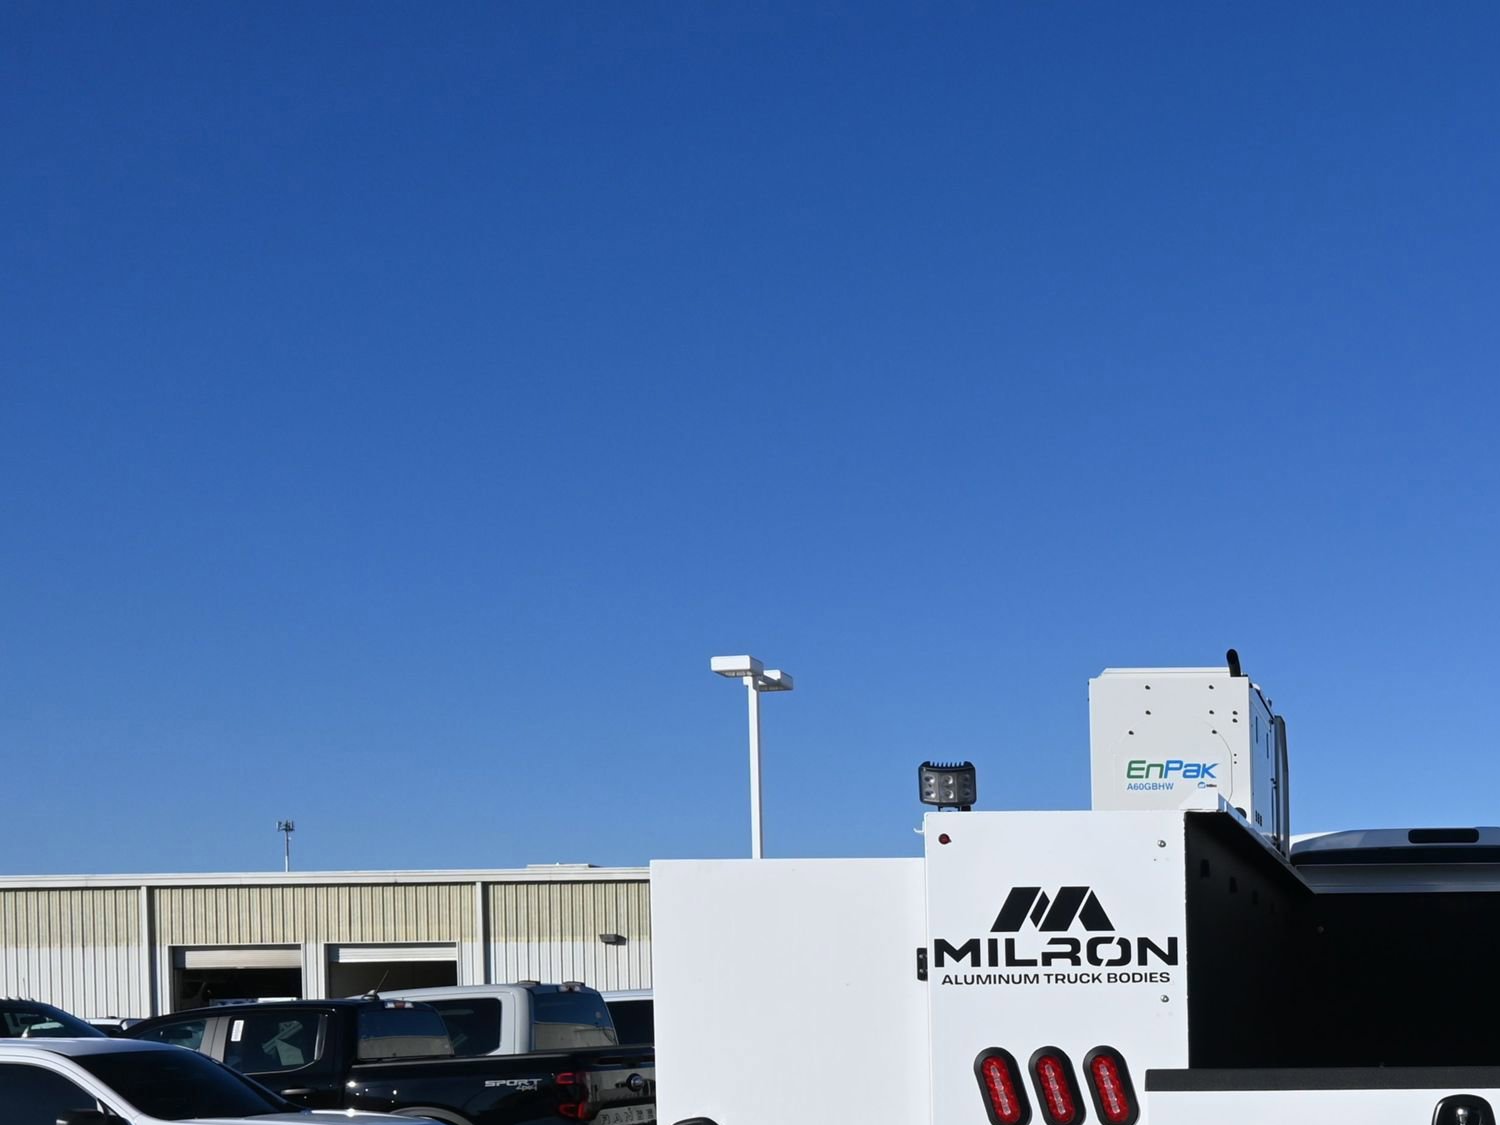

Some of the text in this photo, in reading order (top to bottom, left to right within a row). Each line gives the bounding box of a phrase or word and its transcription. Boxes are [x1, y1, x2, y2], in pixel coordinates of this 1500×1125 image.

[1126, 760, 1219, 779] EnPak
[1127, 782, 1174, 791] A60GBHW
[934, 936, 1178, 967] MILRON
[941, 972, 1170, 985] ALUMINUM TRUCK BODIES
[485, 1079, 543, 1088] SPORT
